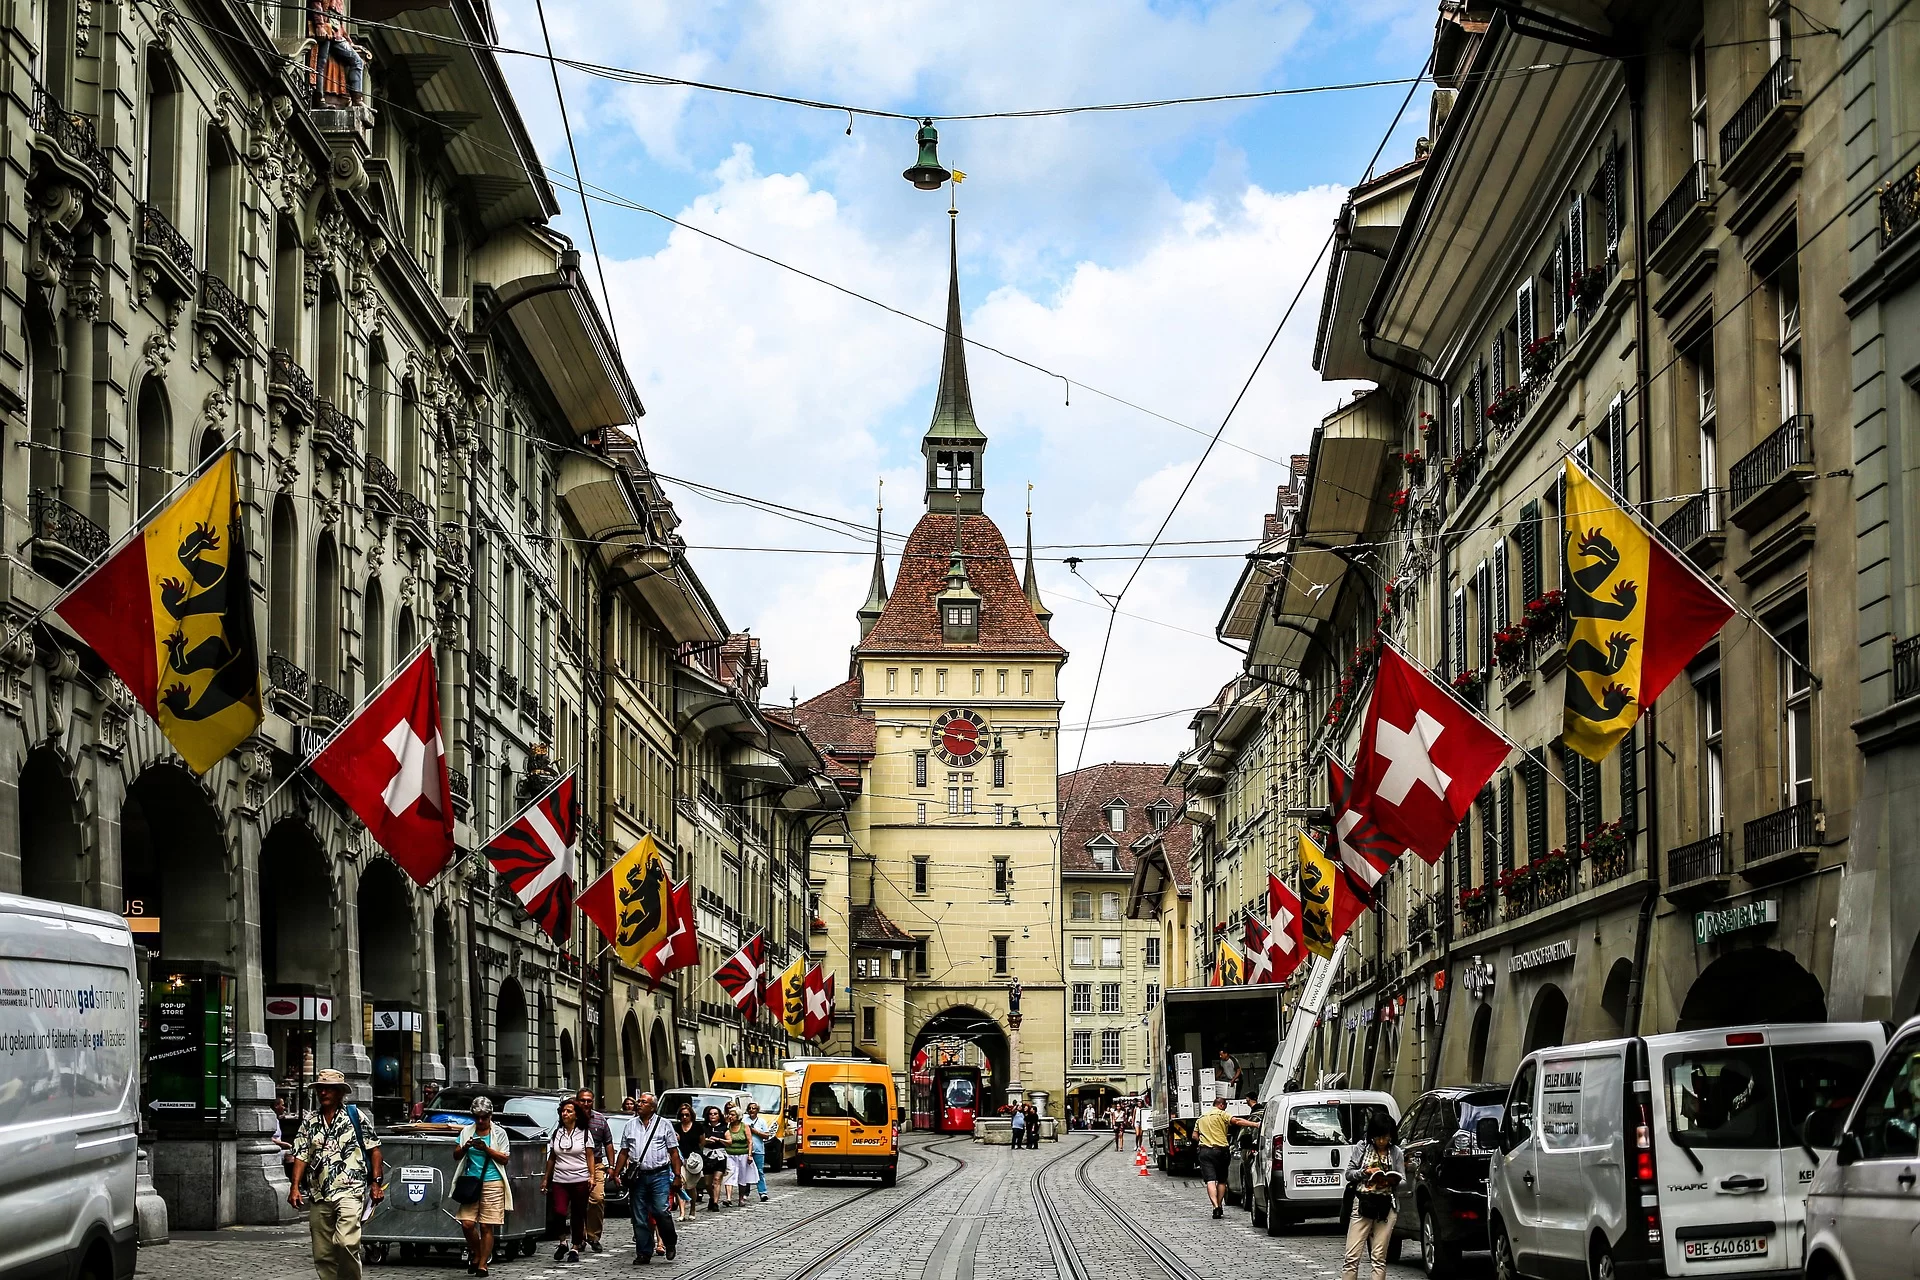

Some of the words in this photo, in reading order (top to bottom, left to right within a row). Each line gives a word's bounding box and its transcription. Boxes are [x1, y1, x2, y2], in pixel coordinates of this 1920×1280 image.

[1706, 901, 1766, 936] DOSENBACH
[29, 988, 77, 1009] FONDATION
[77, 985, 95, 1014] gad
[95, 991, 126, 1010] STIFTUNG
[9, 1029, 36, 1056] gelaunt
[37, 1029, 51, 1049] und
[51, 1028, 78, 1049] faltenfrei
[83, 1029, 91, 1048] die
[158, 1046, 197, 1060] BUNDESPLATZ
[1544, 1073, 1559, 1088] KELLER
[1560, 1072, 1575, 1087] KLIMA
[1575, 1071, 1582, 1087] AG
[1667, 1183, 1708, 1192] TRAFIC
